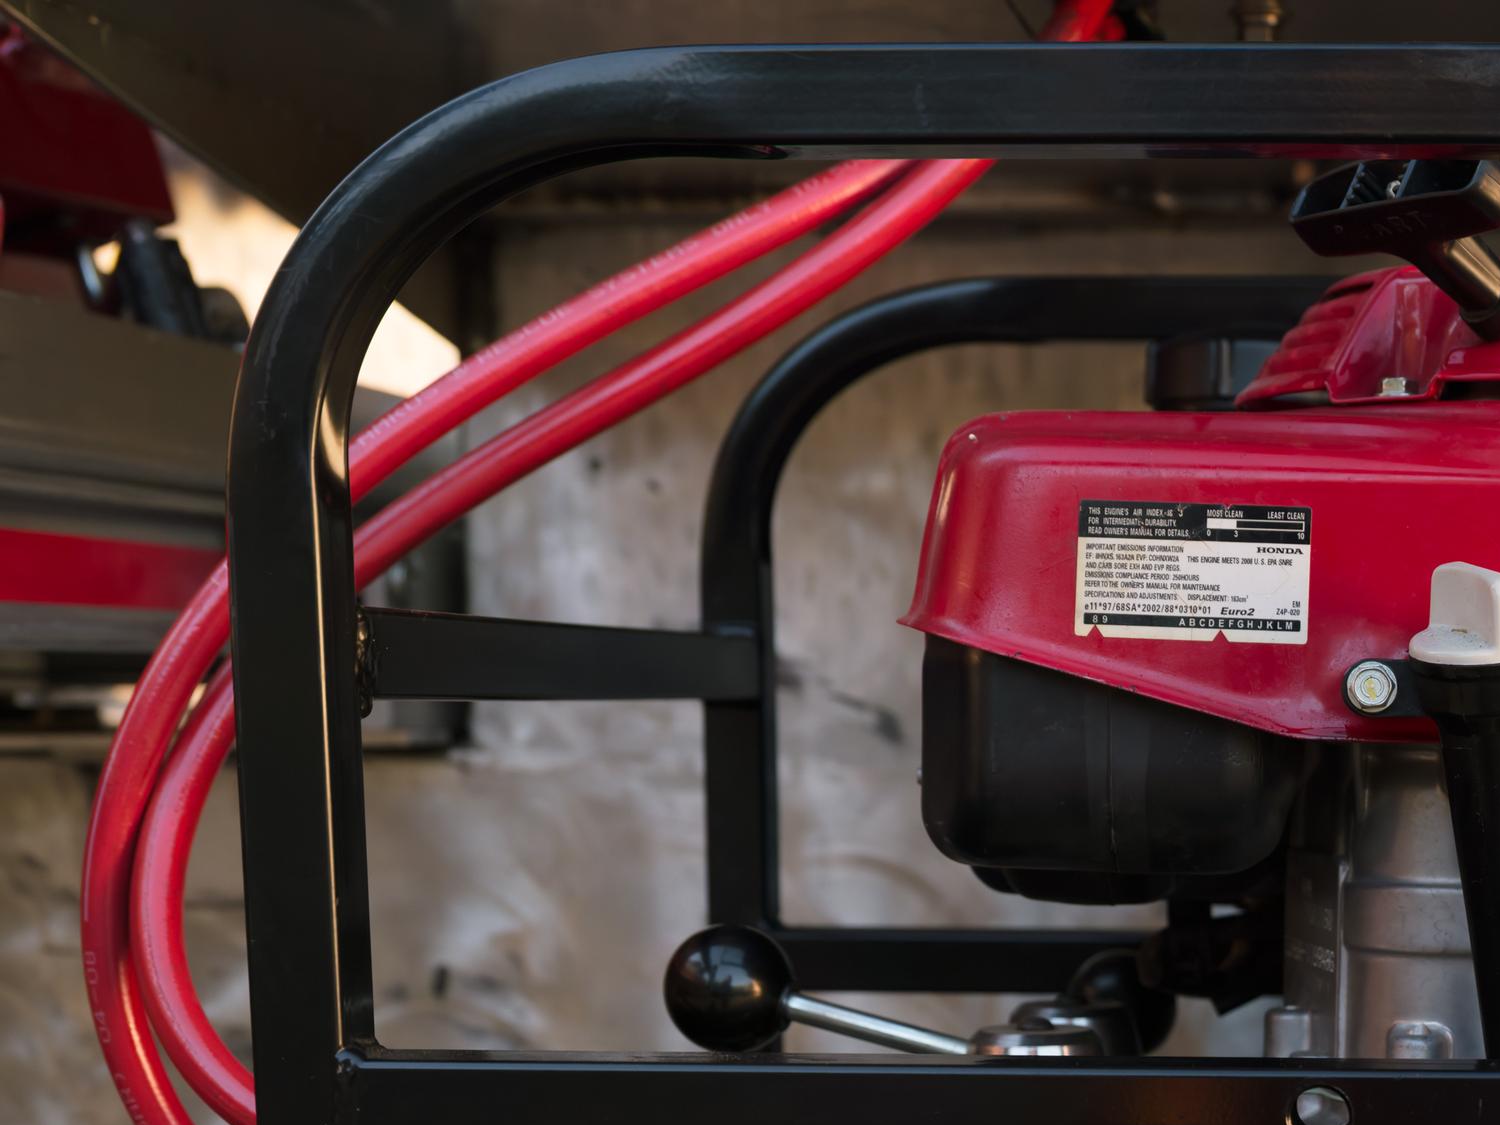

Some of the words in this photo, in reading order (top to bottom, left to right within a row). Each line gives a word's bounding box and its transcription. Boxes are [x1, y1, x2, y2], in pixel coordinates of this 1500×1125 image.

[1088, 507, 1101, 515] THIS
[1104, 507, 1129, 516] ENGINE'S
[1133, 508, 1142, 516] AIR
[1207, 510, 1223, 518] MOST
[1224, 510, 1244, 518] CLEAN
[1267, 512, 1284, 520] LEAST
[1287, 512, 1305, 520] CLEAN
[1104, 527, 1128, 535] OWNER'S
[1130, 528, 1153, 536] MANUAL
[1086, 543, 1116, 551] IMPORTANT
[1118, 544, 1146, 552] EMISSIONS
[1147, 545, 1184, 553] INFORMATION
[1256, 547, 1304, 555] HONDA
[1201, 556, 1220, 564] ENGINE
[1267, 558, 1277, 566] EPA
[1085, 571, 1114, 579] EMISSIONS
[1115, 572, 1149, 580] COMPLIANCE
[1084, 591, 1125, 599] SPECIFICATIONS
[1220, 607, 1255, 616] Euro2
[1276, 608, 1300, 616] Z4P-020
